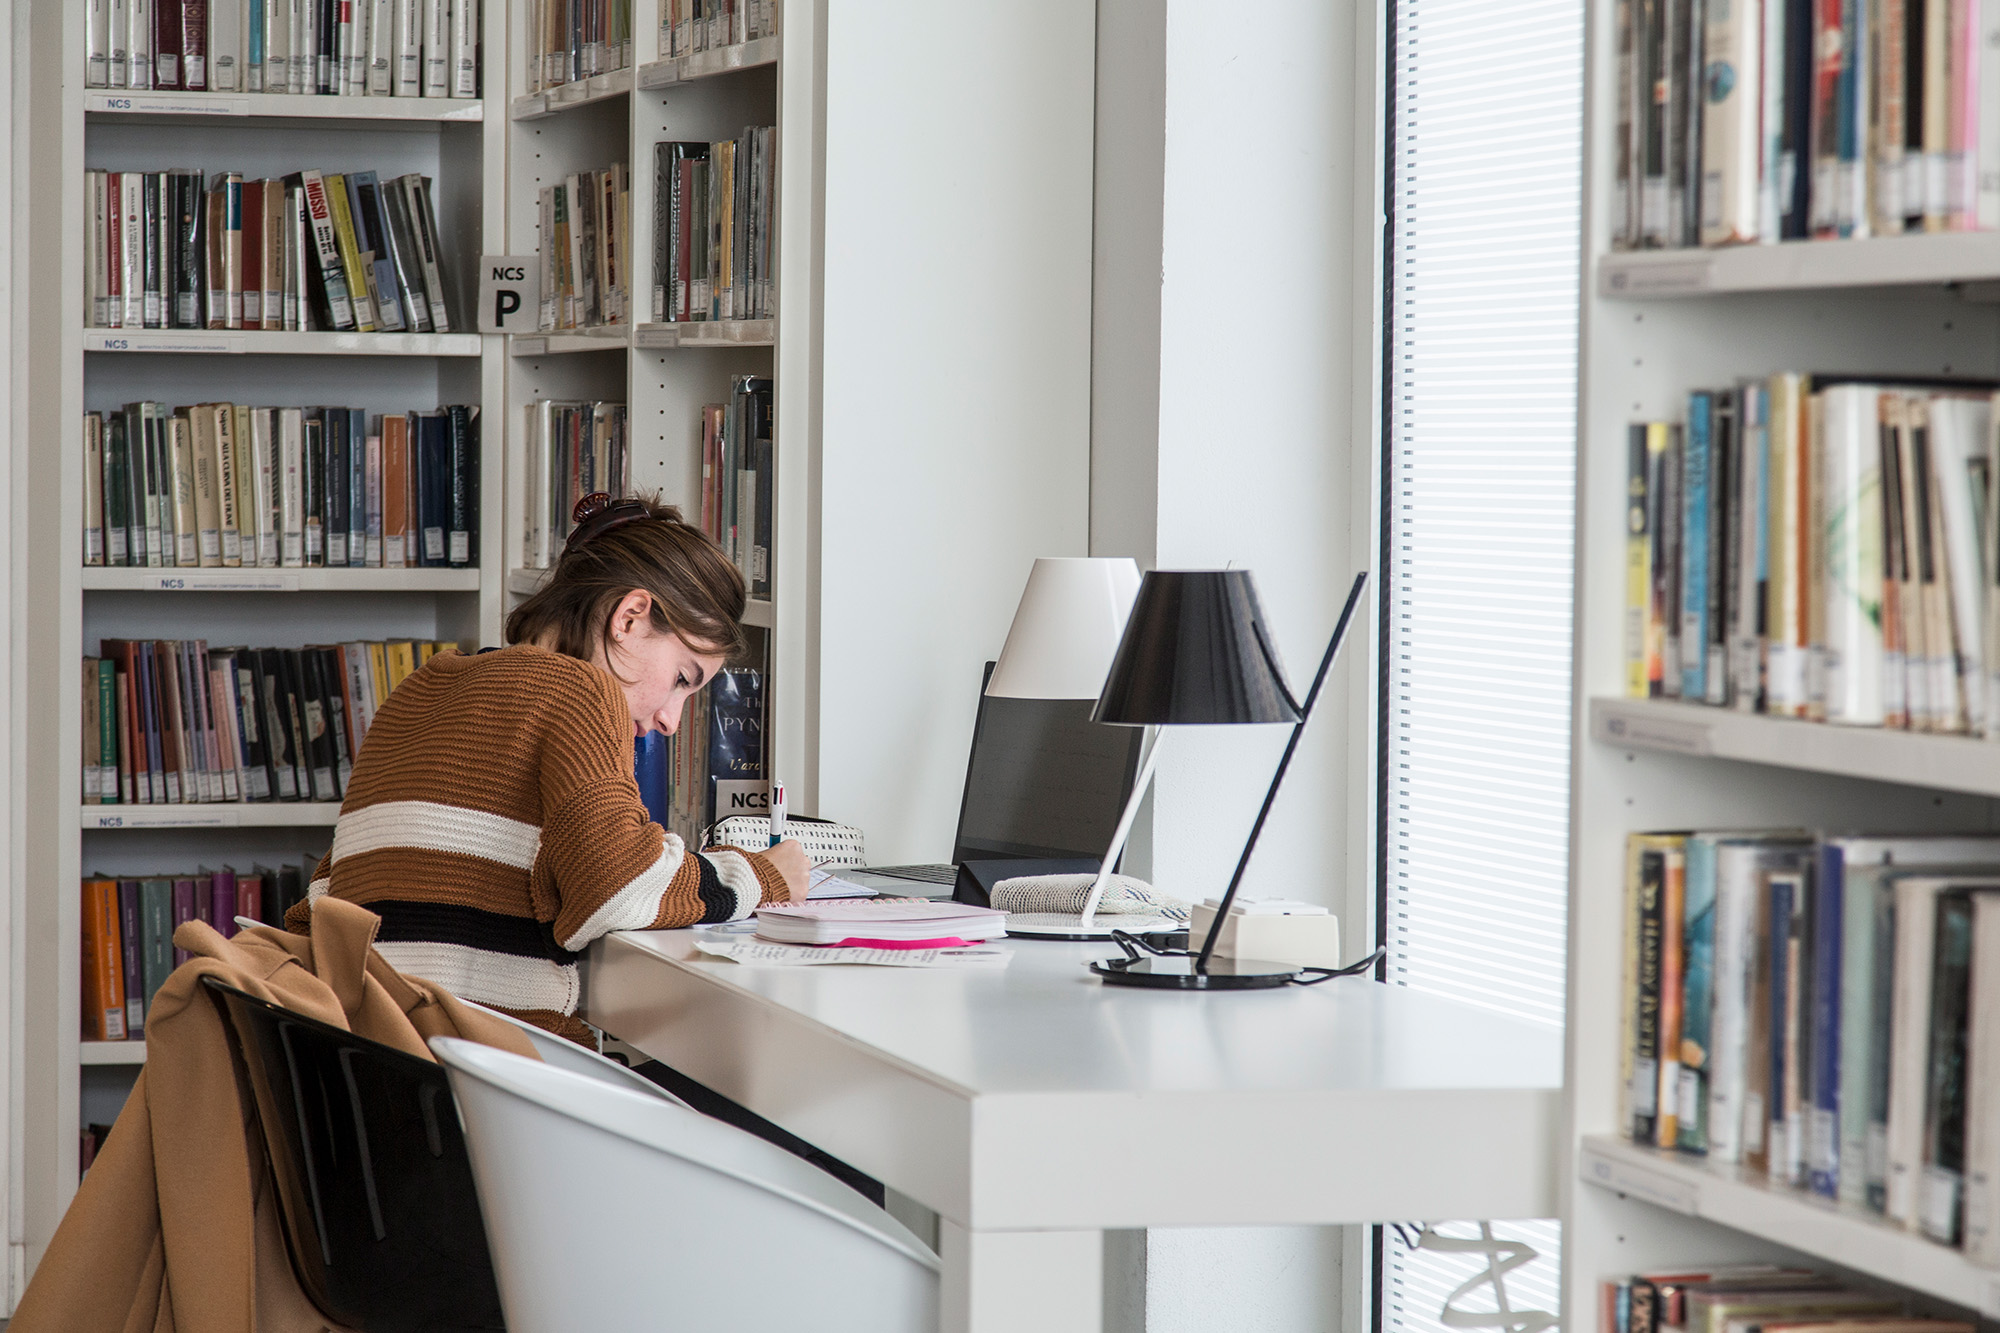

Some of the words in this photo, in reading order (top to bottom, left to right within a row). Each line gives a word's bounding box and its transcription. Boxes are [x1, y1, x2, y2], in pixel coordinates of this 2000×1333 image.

[107, 99, 131, 109] NCS
[305, 183, 329, 220] MUSSO
[493, 267, 525, 280] NCS
[495, 290, 521, 327] P
[104, 339, 128, 349] NCS
[161, 579, 185, 589] NCS
[723, 718, 762, 732] PYN
[731, 793, 768, 808] NCS
[100, 817, 123, 827] NCS
